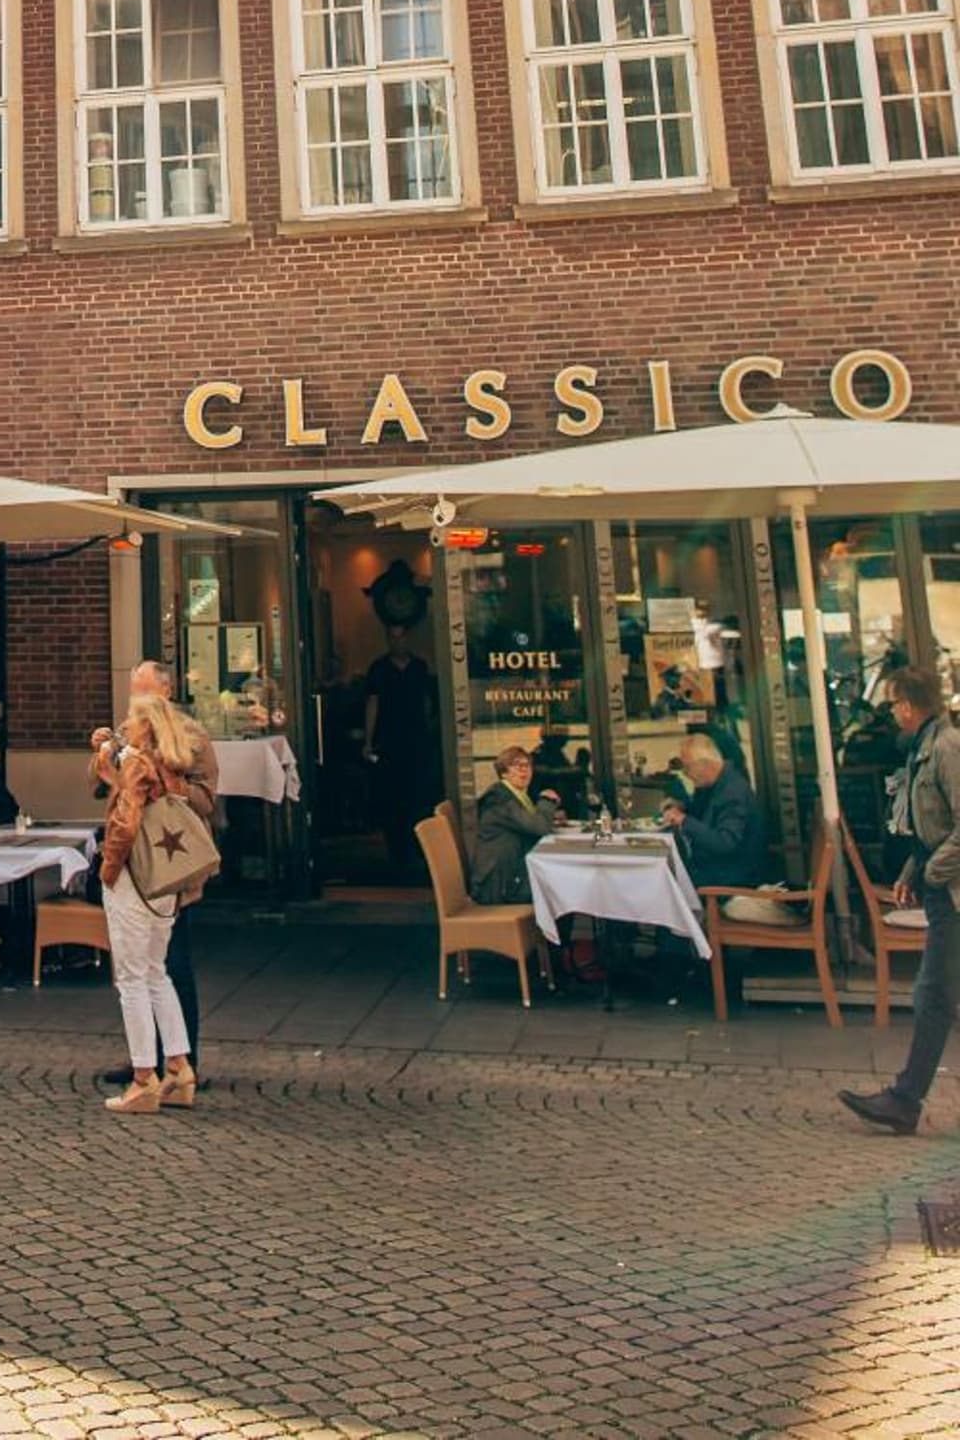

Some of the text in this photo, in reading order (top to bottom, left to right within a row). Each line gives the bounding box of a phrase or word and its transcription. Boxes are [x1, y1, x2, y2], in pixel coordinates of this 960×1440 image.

[183, 349, 912, 449] CLASSICO
[489, 651, 562, 669] HOTEL
[485, 690, 569, 702] RESTAURANT
